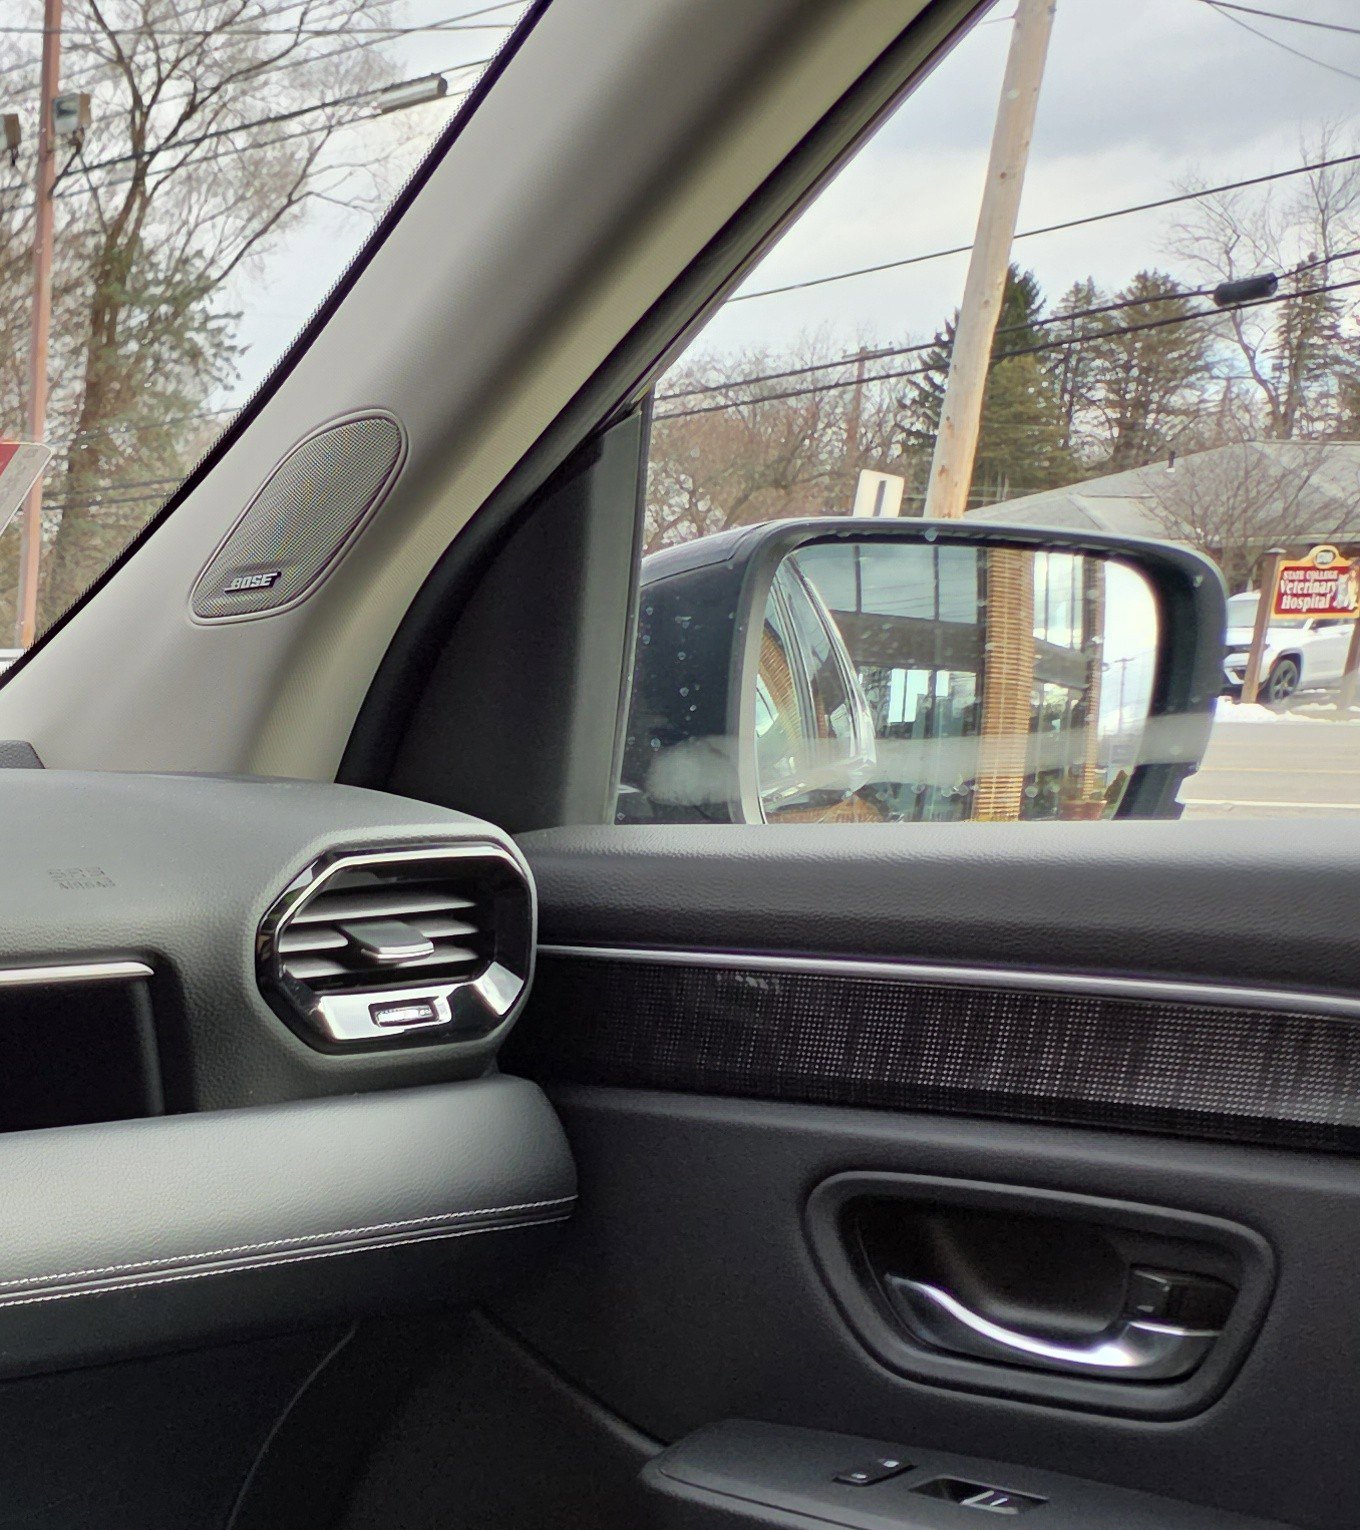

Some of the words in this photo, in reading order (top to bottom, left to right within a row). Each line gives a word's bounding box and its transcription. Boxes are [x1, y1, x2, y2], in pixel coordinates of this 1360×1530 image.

[225, 572, 278, 591] BOSE
[1280, 579, 1337, 597] Veterinary
[1281, 594, 1332, 612] Hospital
